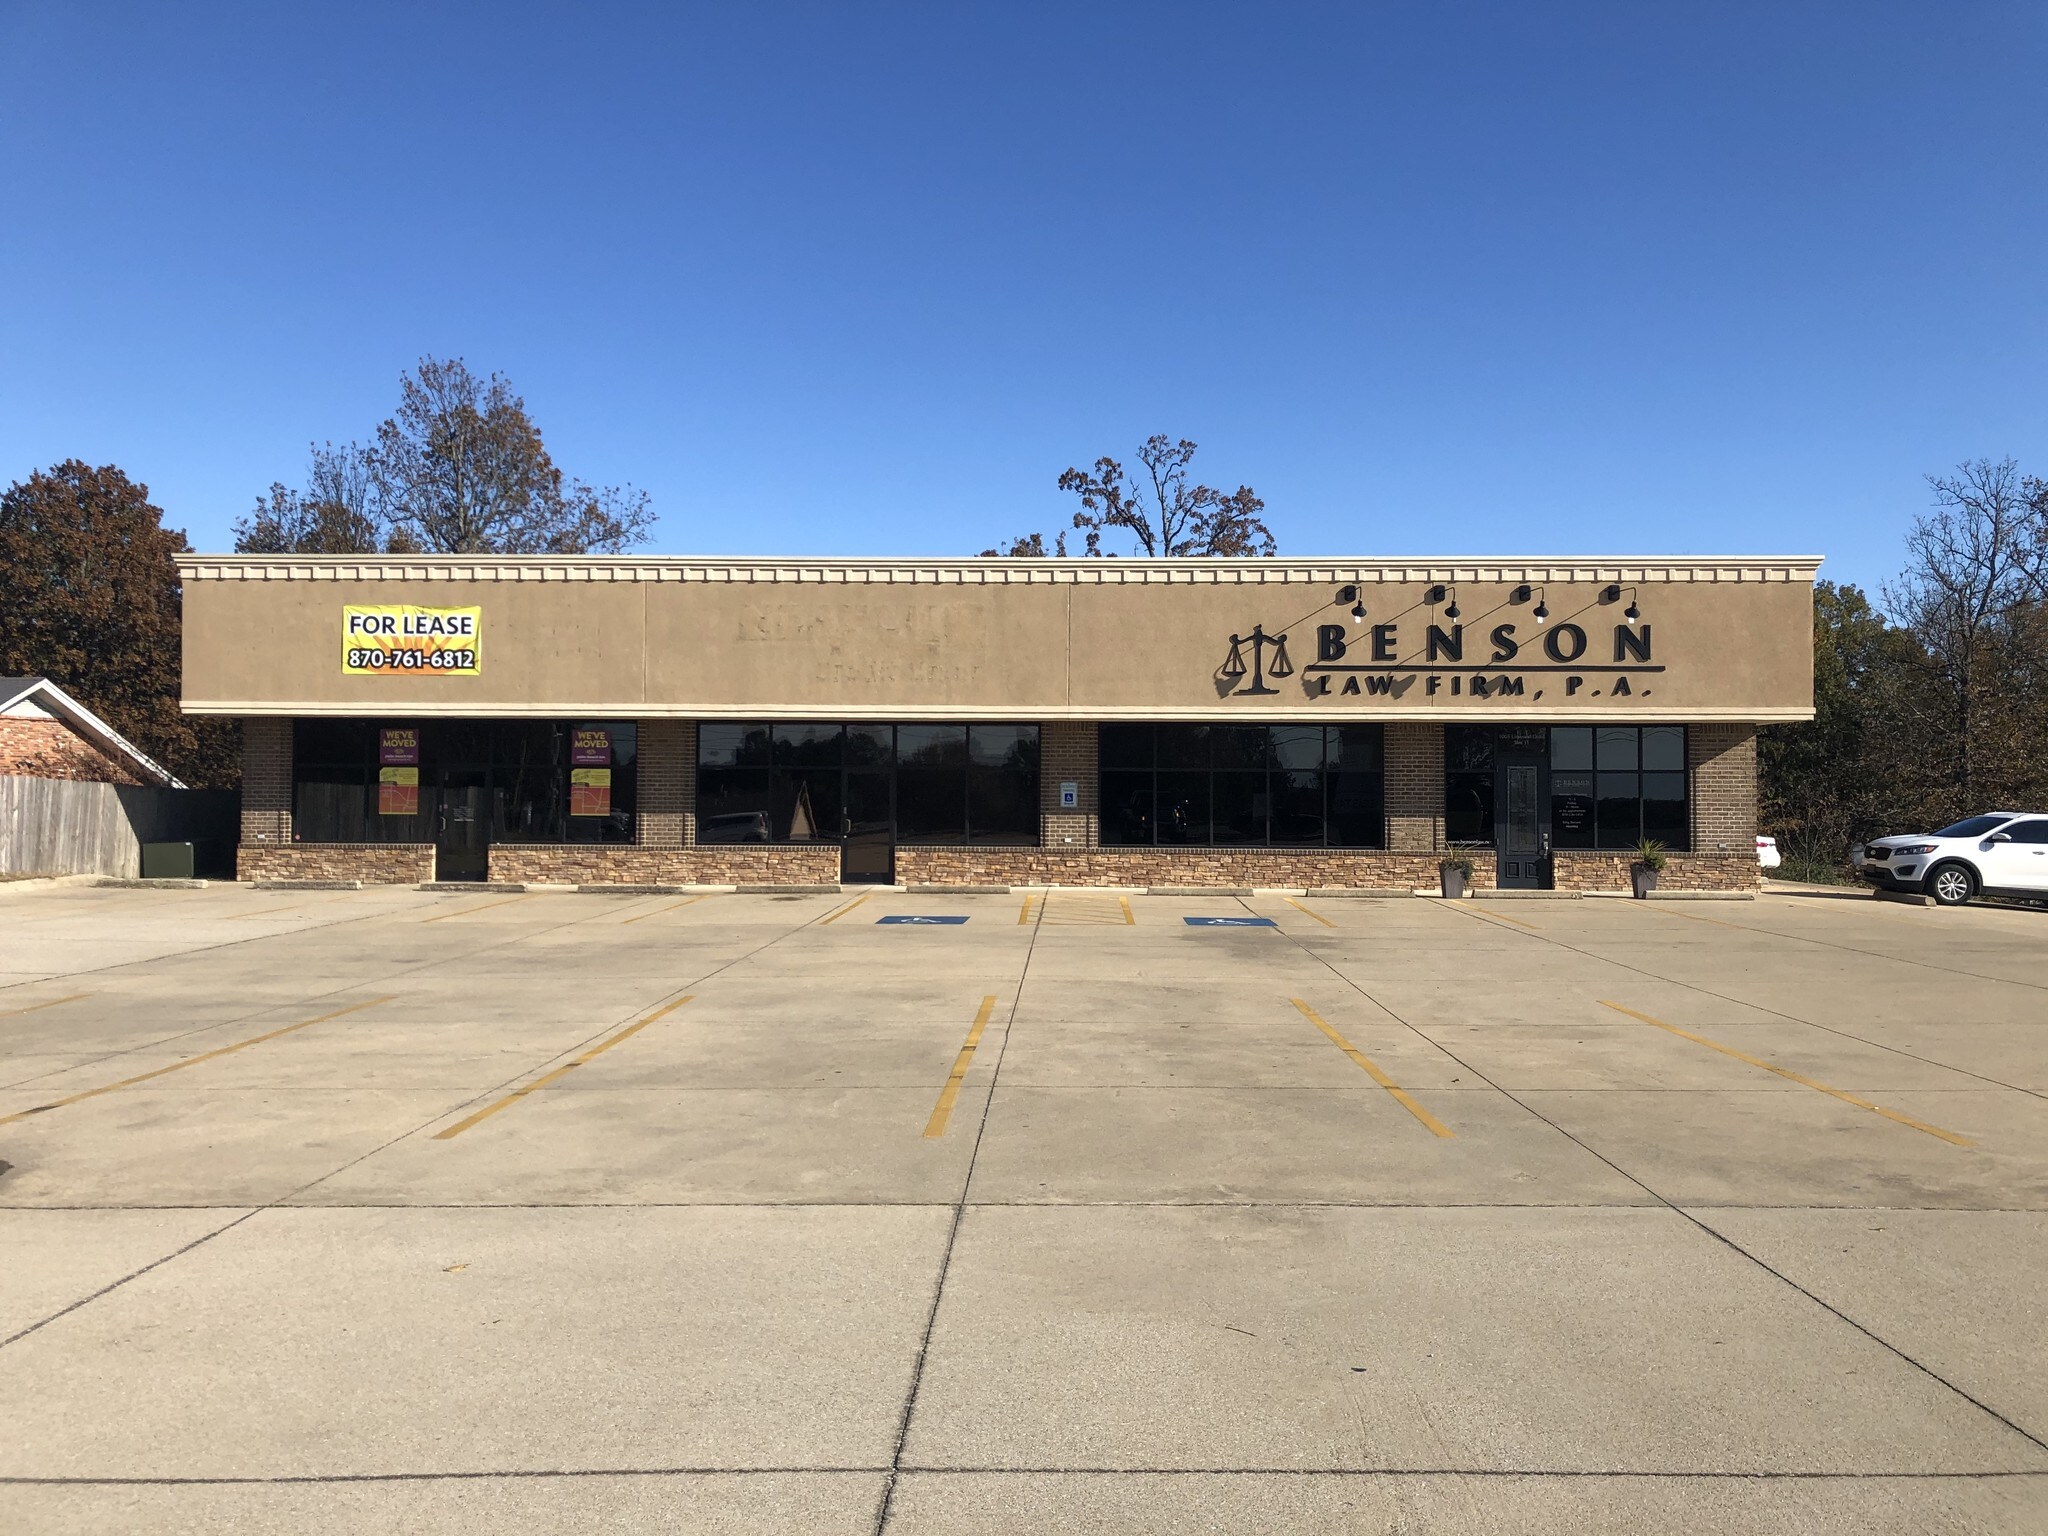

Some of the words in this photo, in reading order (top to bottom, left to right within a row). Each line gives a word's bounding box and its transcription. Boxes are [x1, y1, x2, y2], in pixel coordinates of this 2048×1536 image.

[350, 616, 396, 634] FOR
[404, 616, 472, 635] LEASE
[1317, 623, 1652, 662] BENSON
[349, 649, 475, 668] 870-761-6812
[1320, 675, 1394, 696] LAW
[1426, 675, 1543, 701] FIRM,
[385, 730, 414, 739] WE'VE
[577, 731, 606, 740] WE'VE
[383, 739, 417, 748] MOVED
[574, 740, 609, 748] MOVED
